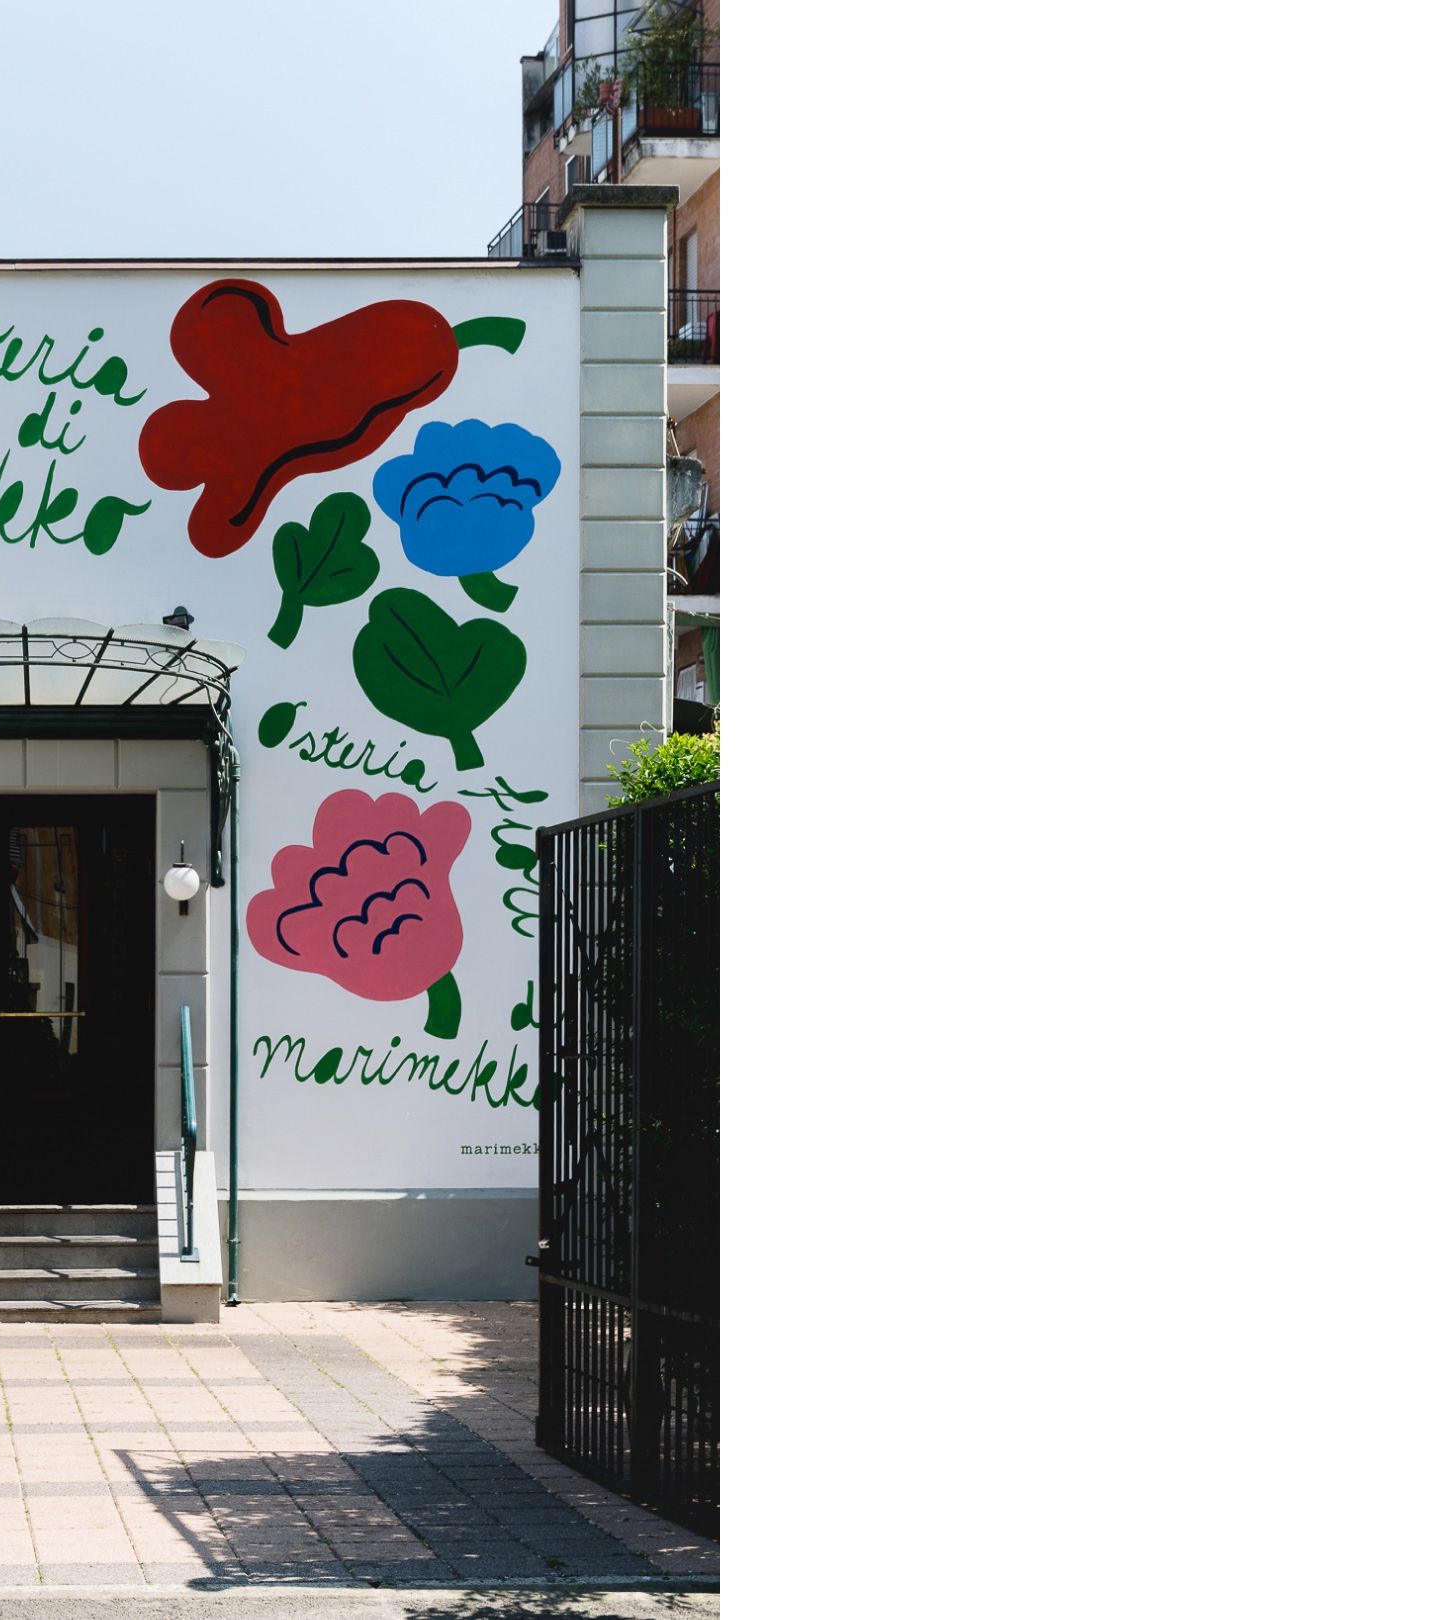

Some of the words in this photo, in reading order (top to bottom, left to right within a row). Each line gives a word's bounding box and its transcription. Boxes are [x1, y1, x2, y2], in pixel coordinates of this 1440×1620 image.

[18, 391, 87, 455] di
[258, 701, 438, 794] Osteria
[460, 1142, 540, 1156] marimekk
